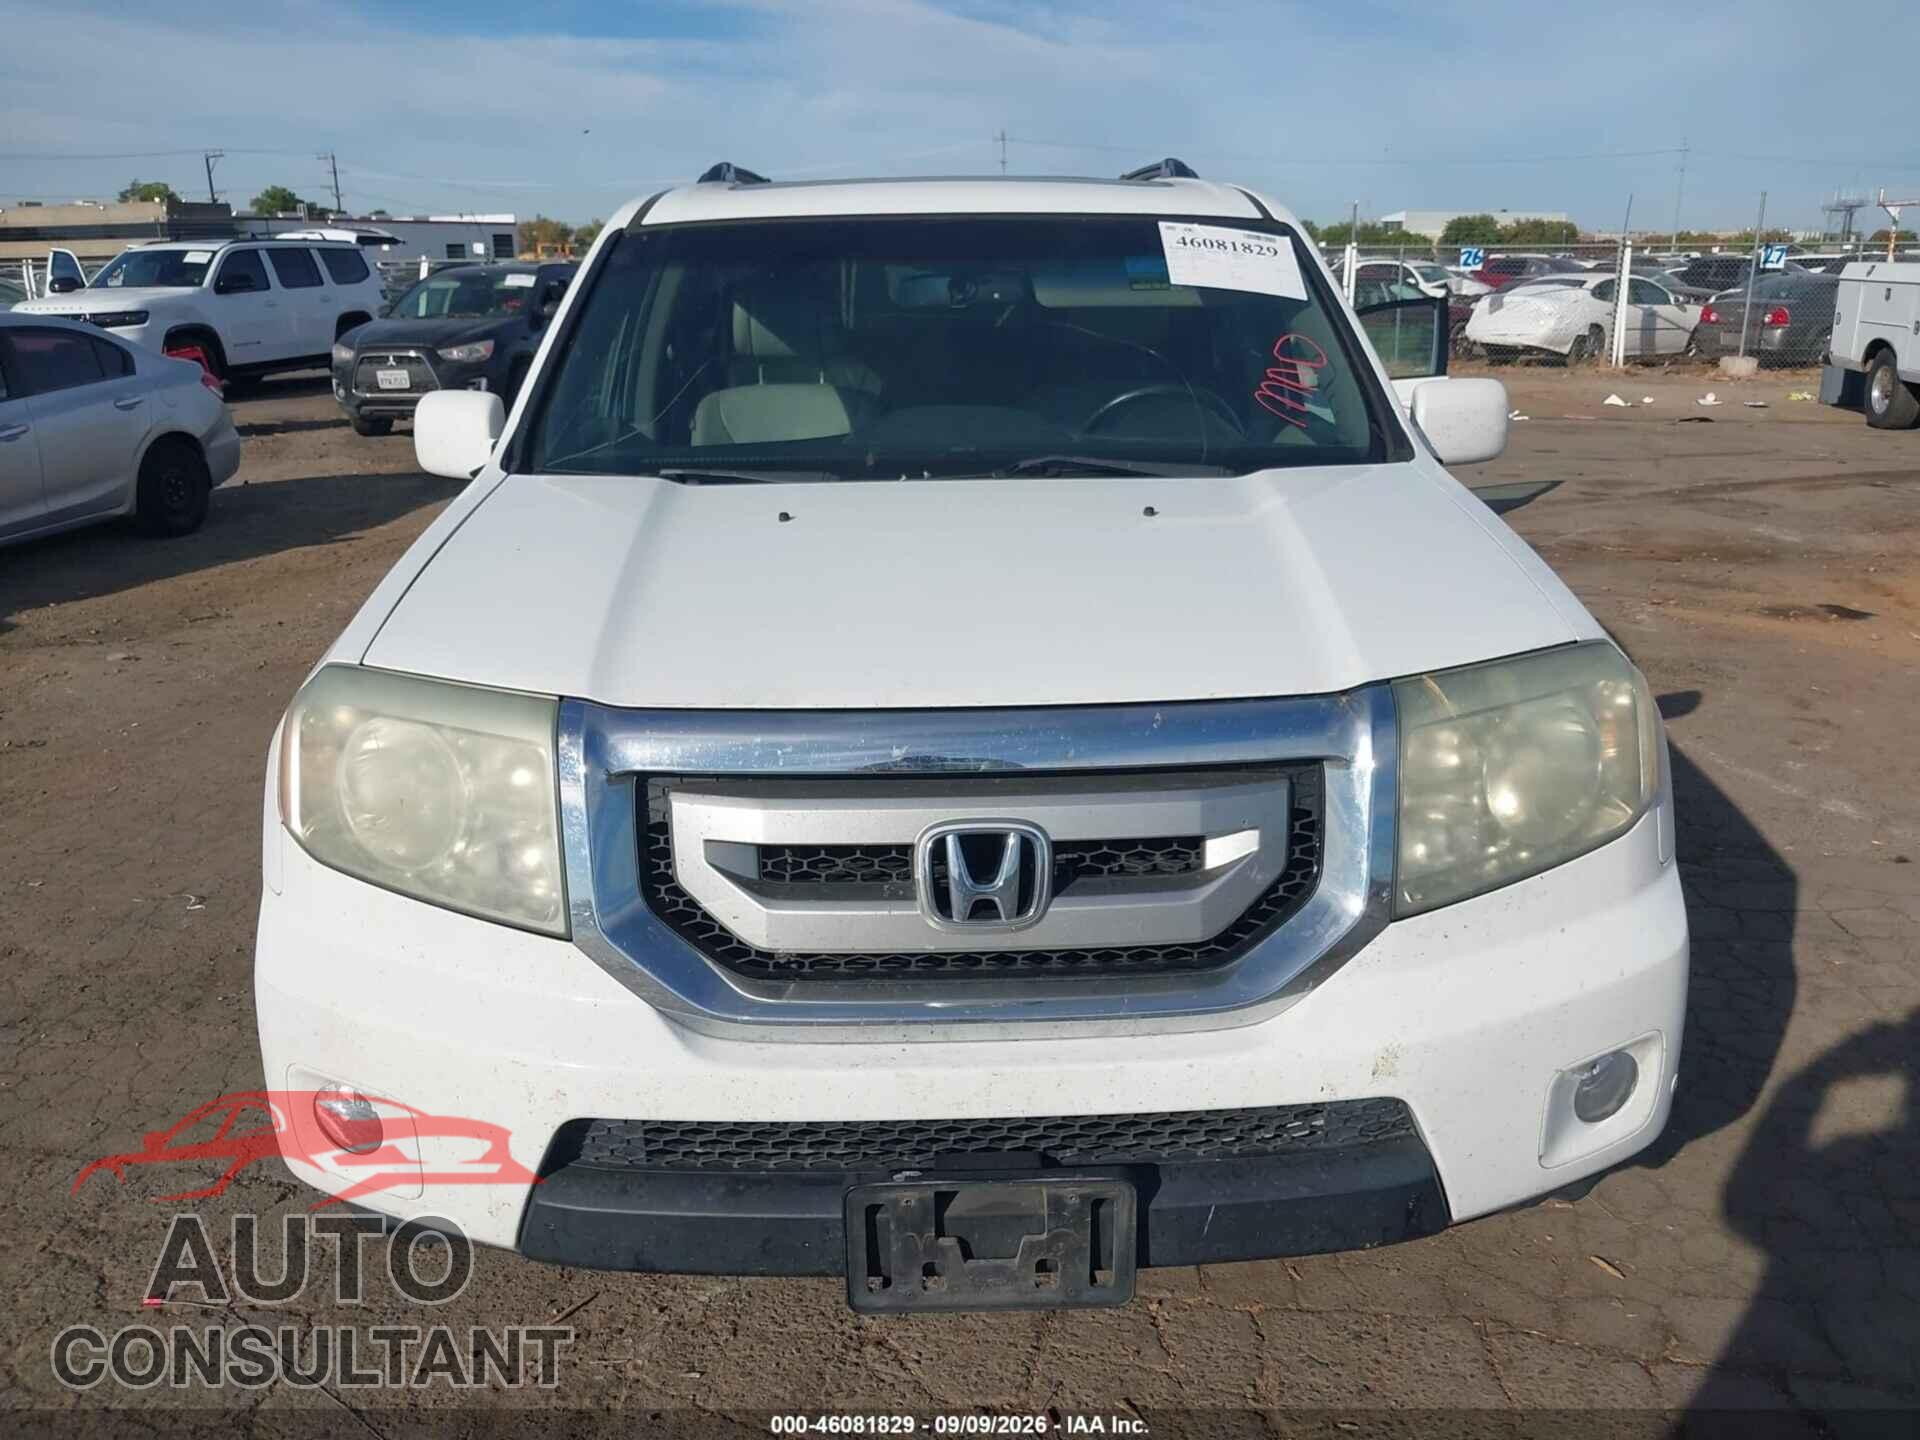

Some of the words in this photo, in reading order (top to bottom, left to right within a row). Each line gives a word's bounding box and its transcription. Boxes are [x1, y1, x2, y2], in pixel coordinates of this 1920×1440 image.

[1176, 236, 1279, 258] 46081829
[1461, 248, 1484, 266] 26
[1762, 243, 1788, 265] 27
